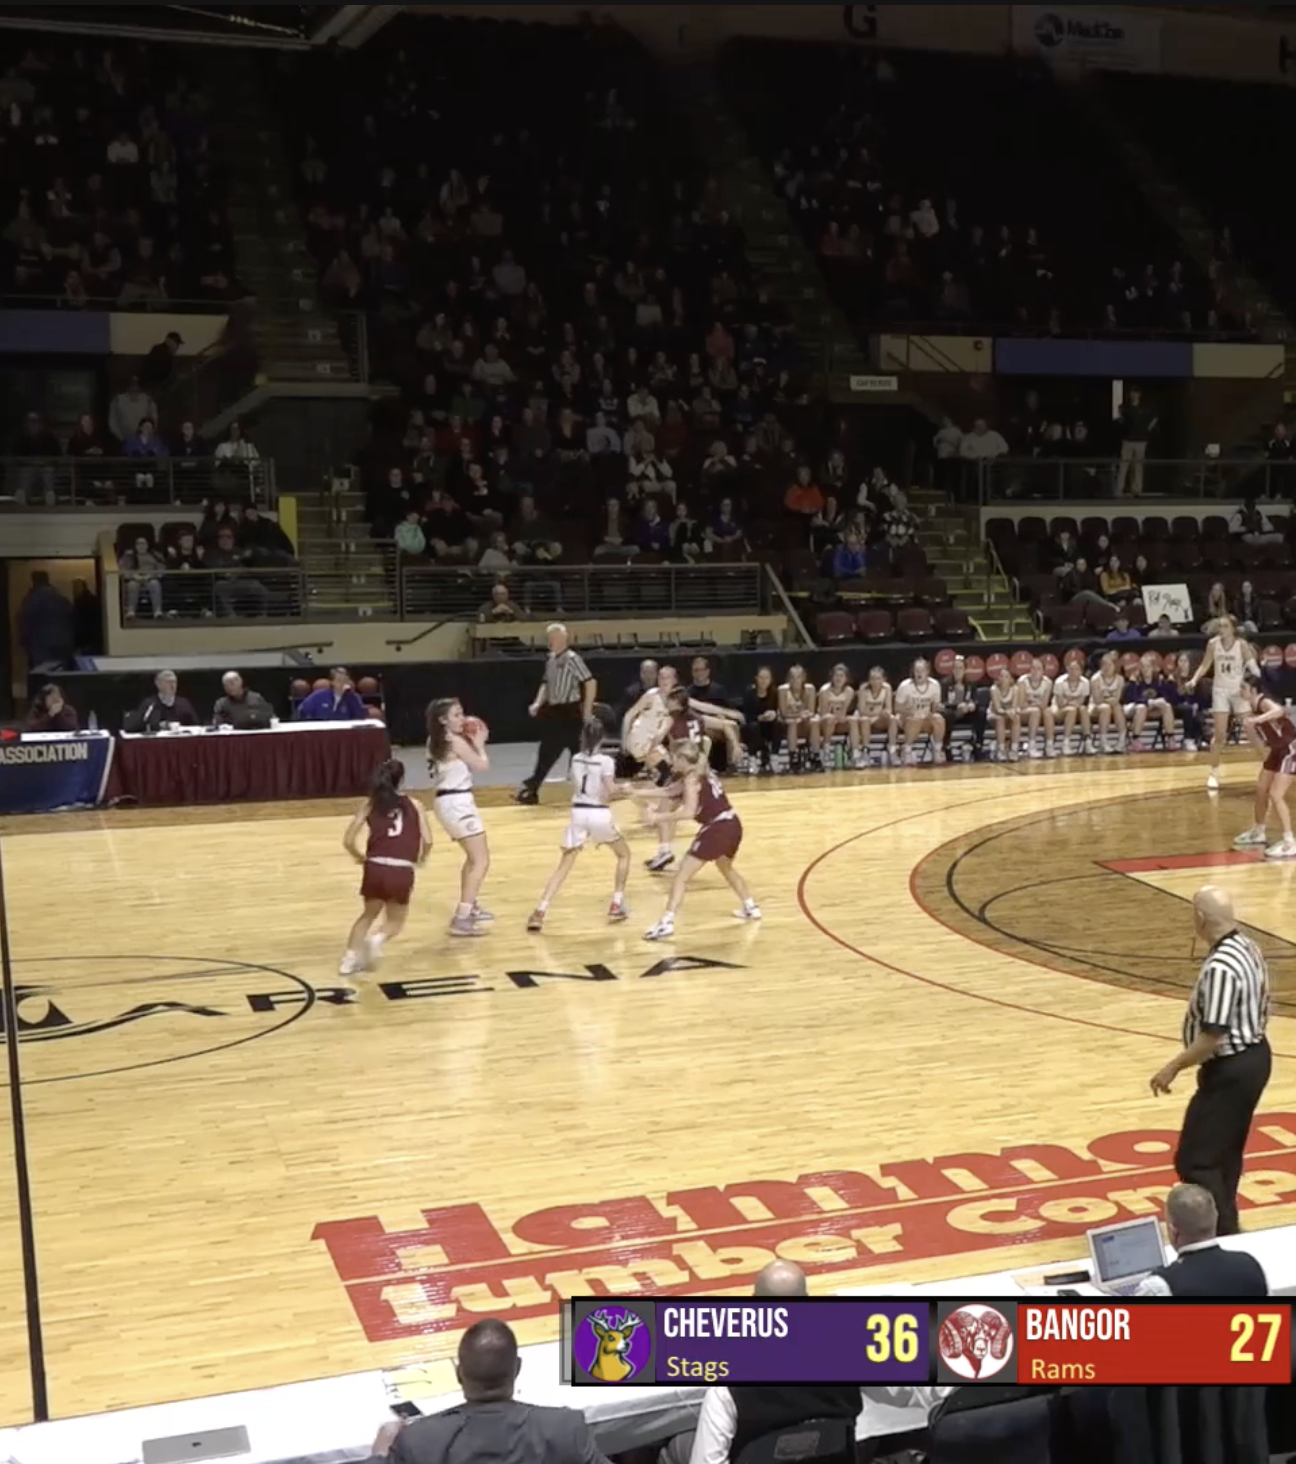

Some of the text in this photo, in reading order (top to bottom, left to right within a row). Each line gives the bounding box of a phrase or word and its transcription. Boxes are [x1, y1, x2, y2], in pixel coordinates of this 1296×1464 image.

[843, 5, 877, 38] G
[113, 955, 748, 1017] ARENA
[380, 1221, 904, 1325] Lumber
